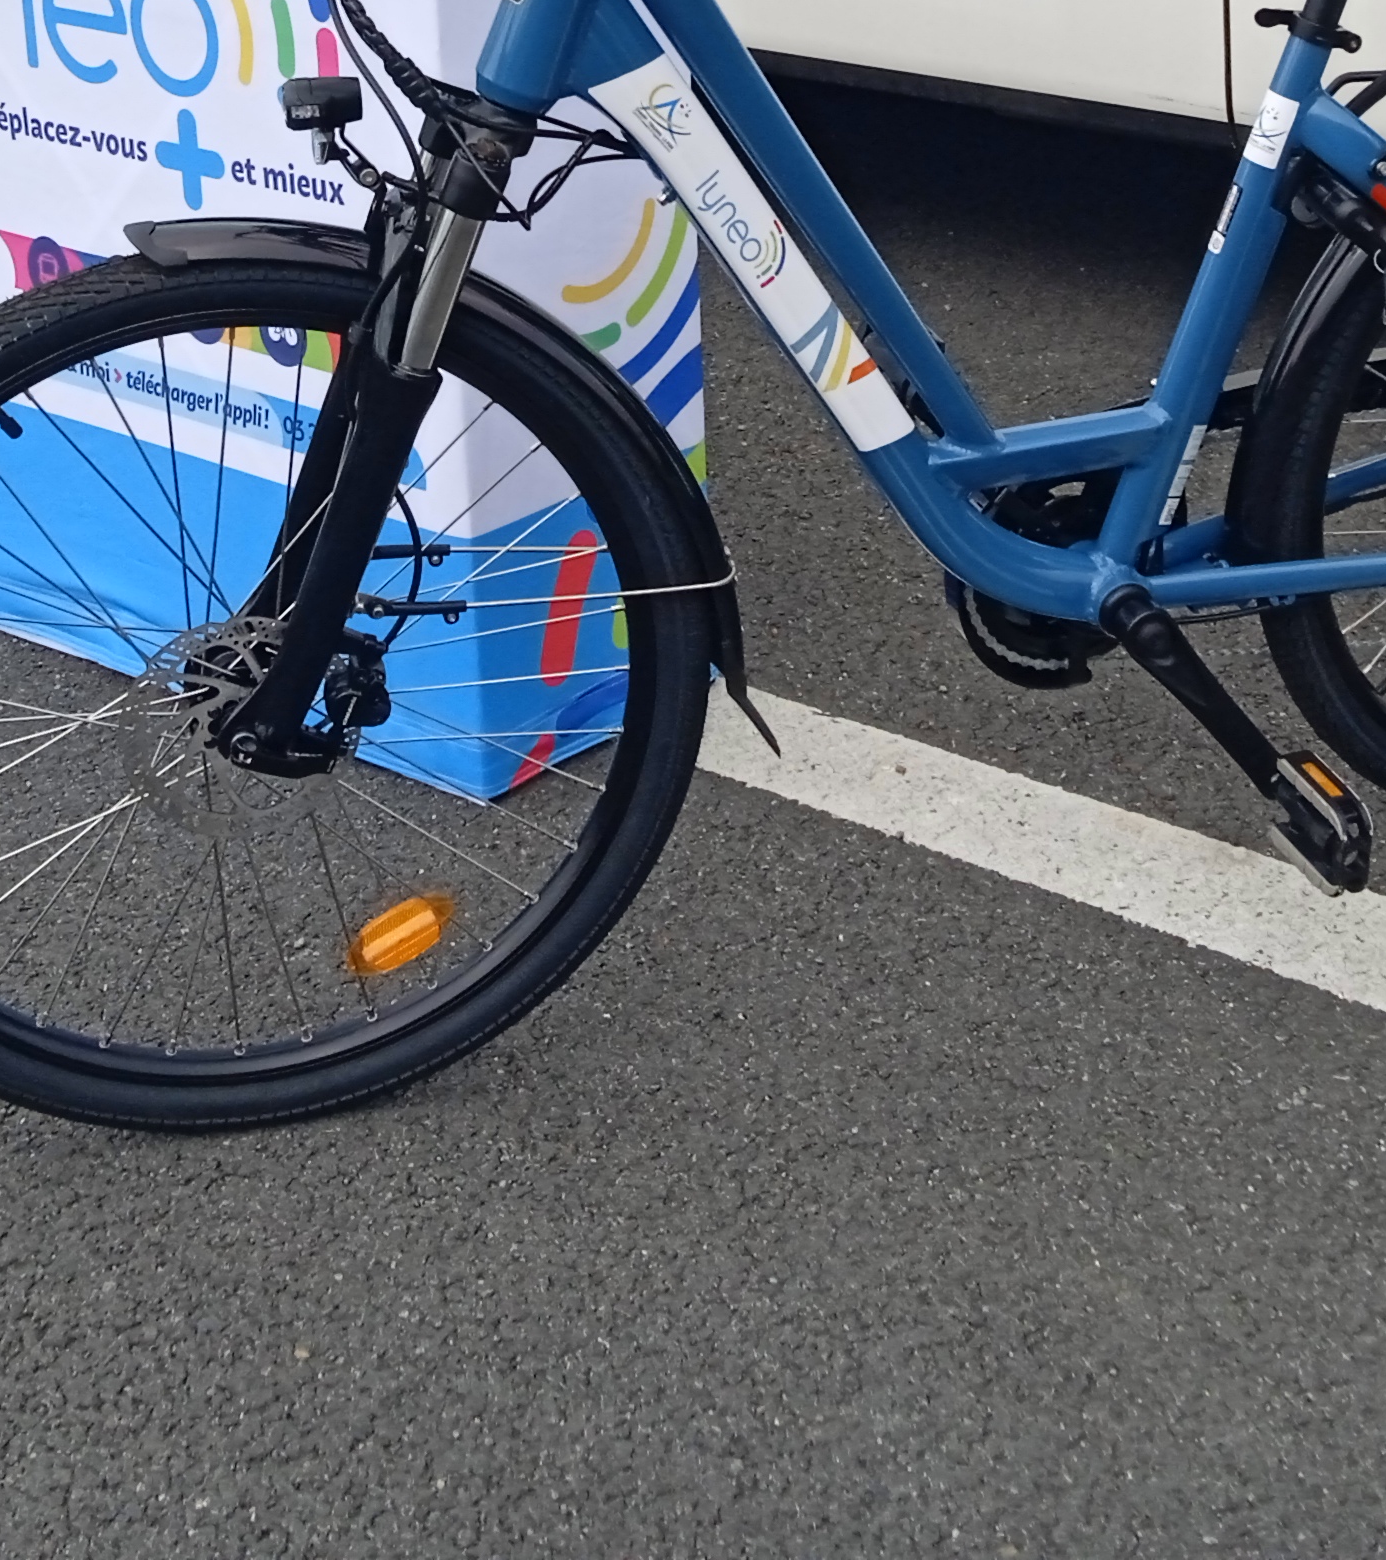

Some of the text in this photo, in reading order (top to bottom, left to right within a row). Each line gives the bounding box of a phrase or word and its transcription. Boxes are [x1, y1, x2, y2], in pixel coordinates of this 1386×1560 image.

[231, 158, 256, 186] et
[262, 163, 345, 207] mieux
[695, 169, 762, 263] lyneo
[125, 369, 213, 412] télécharger
